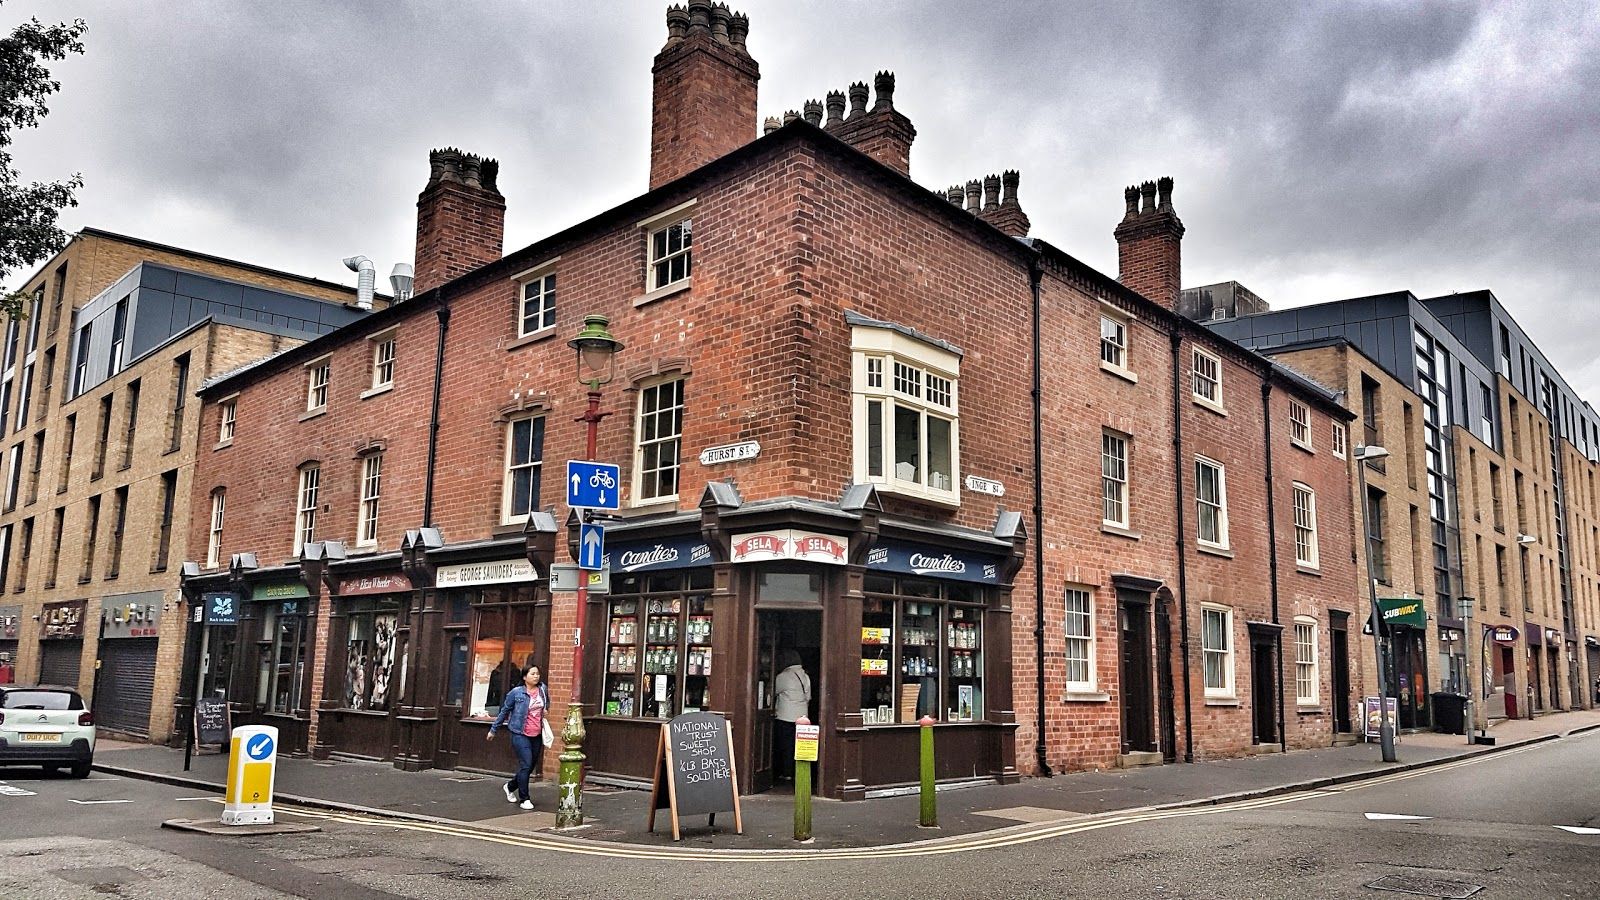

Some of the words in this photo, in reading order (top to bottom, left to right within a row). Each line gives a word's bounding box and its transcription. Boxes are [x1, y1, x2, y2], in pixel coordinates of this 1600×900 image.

[708, 448, 735, 461] HURST
[972, 479, 987, 491] INGE
[747, 538, 772, 551] SELA
[808, 539, 833, 552] SELA
[620, 544, 679, 566] Candies
[909, 553, 966, 571] Candies
[459, 566, 481, 582] GEORGE
[483, 564, 513, 581] SAUNDERS
[1383, 604, 1418, 619] SUBWAY
[673, 722, 720, 733] NATIONAL
[686, 731, 717, 740] TRUST
[679, 740, 711, 751] SWEET
[691, 746, 717, 756] SHOP
[701, 758, 726, 769] BAGS
[686, 771, 710, 783] SOLD
[712, 767, 731, 779] HERE
